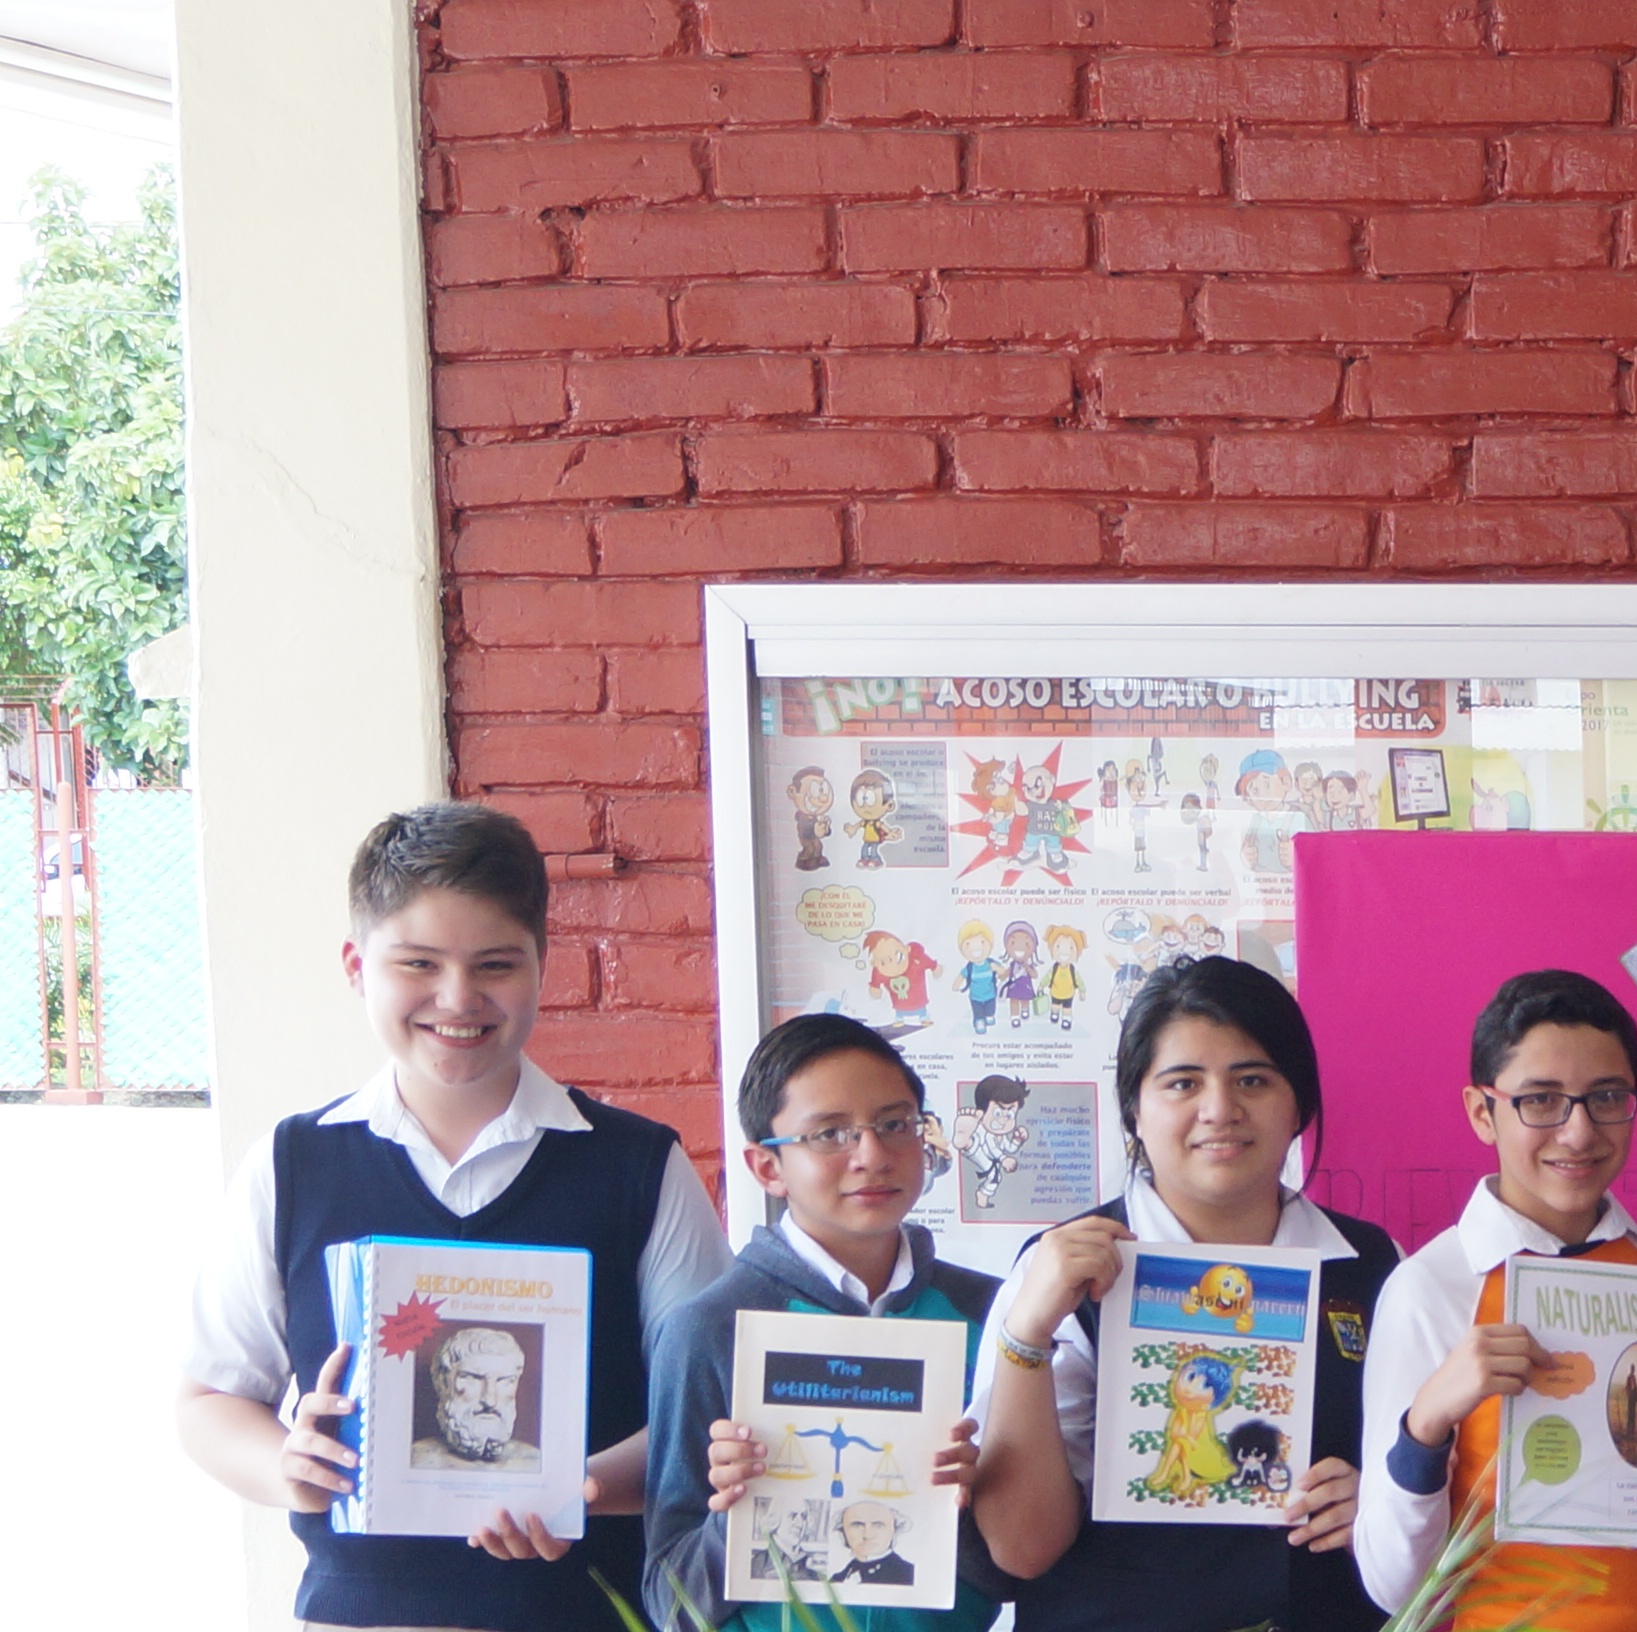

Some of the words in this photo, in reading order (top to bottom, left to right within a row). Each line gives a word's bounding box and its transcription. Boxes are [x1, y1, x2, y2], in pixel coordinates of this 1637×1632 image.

[935, 678, 1053, 709] ACOSO
[1059, 678, 1210, 710] ESCOLAR
[1213, 680, 1243, 709] O
[1259, 713, 1288, 730] EN
[1298, 713, 1327, 730] LA
[1338, 713, 1436, 731] ESCUELA
[988, 888, 1017, 896] escolar
[1020, 888, 1047, 898] puede
[1129, 888, 1158, 896] escolar
[1160, 888, 1187, 898] puede
[1204, 888, 1231, 896] verbal
[972, 1041, 1001, 1050] Procura
[919, 1053, 954, 1061] escolares
[997, 1051, 1024, 1061] amigos
[1032, 1051, 1053, 1059] evita
[996, 1061, 1025, 1071] lugares
[1020, 1151, 1051, 1159] formas
[1053, 1151, 1091, 1161] posibles
[1041, 1162, 1092, 1170] defenderte
[1050, 1174, 1091, 1183] cualquier
[1031, 1196, 1063, 1205] puedas
[416, 1273, 554, 1300] HEDONISMO
[463, 1303, 495, 1314] placer
[499, 1303, 516, 1312] del
[537, 1304, 583, 1316] humano
[827, 1359, 863, 1377] The
